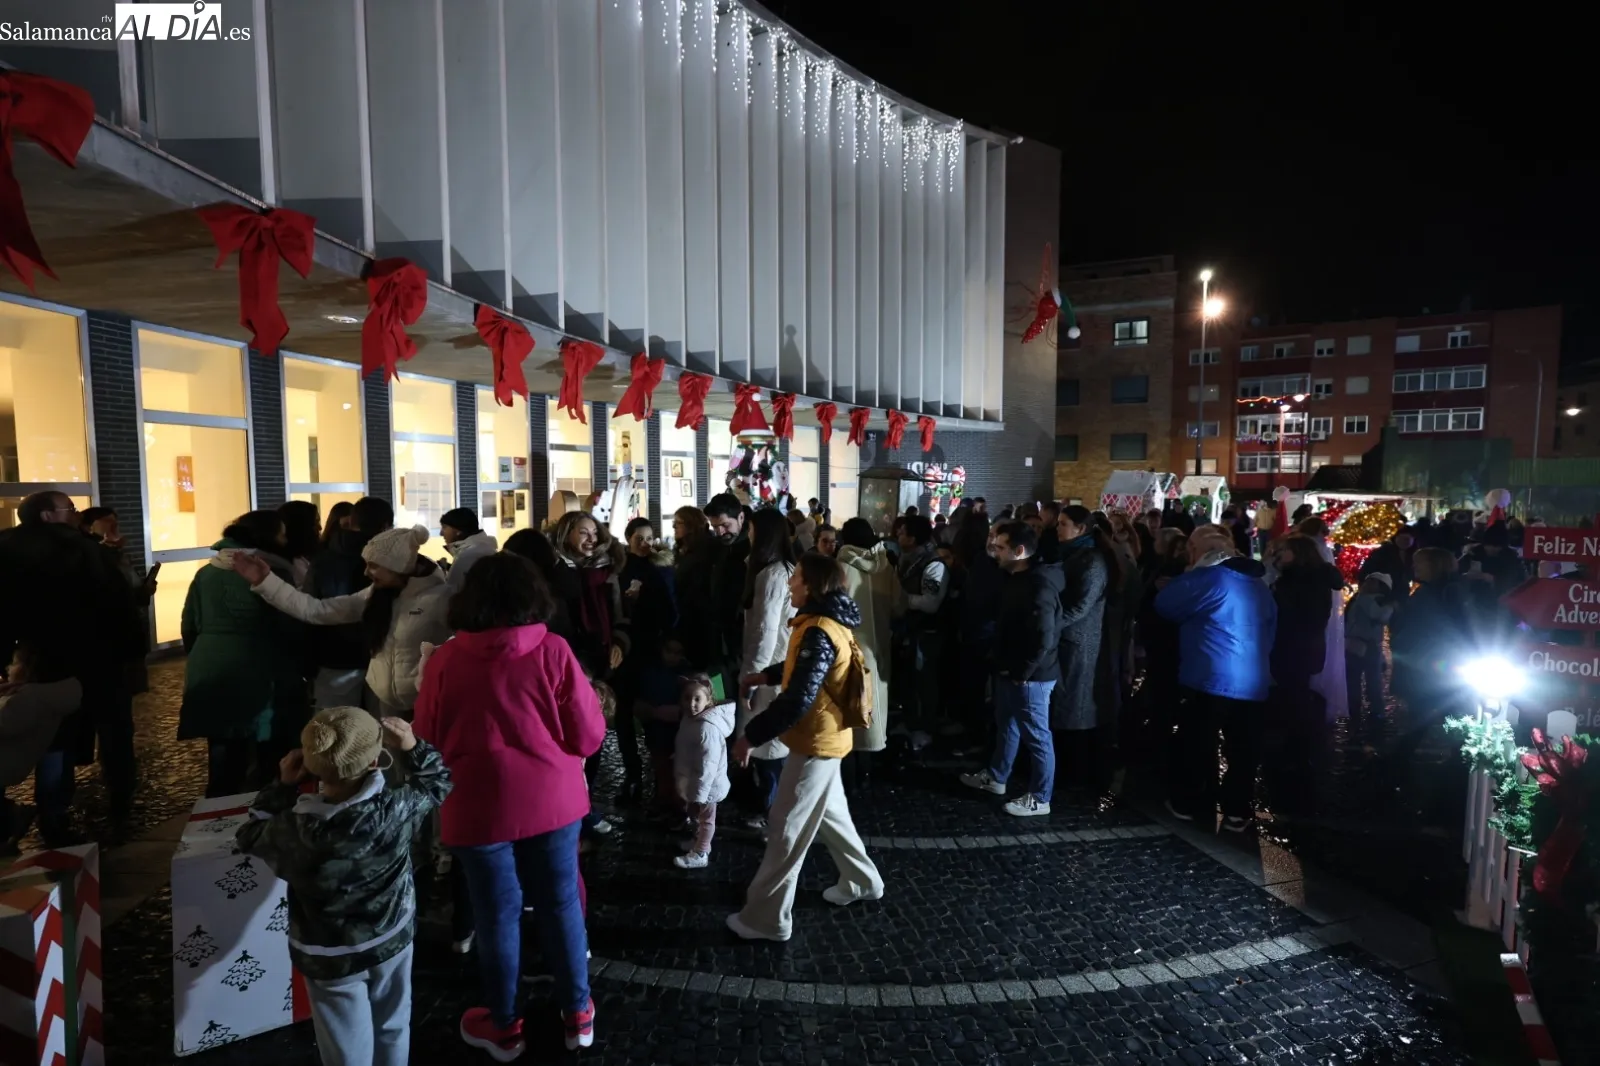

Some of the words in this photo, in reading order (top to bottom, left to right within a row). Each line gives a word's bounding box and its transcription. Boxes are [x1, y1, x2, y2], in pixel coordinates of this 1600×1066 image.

[1533, 535, 1577, 555] Feliz
[1581, 536, 1600, 557] N
[1553, 603, 1600, 625] Adve
[1529, 651, 1600, 678] Chocol
